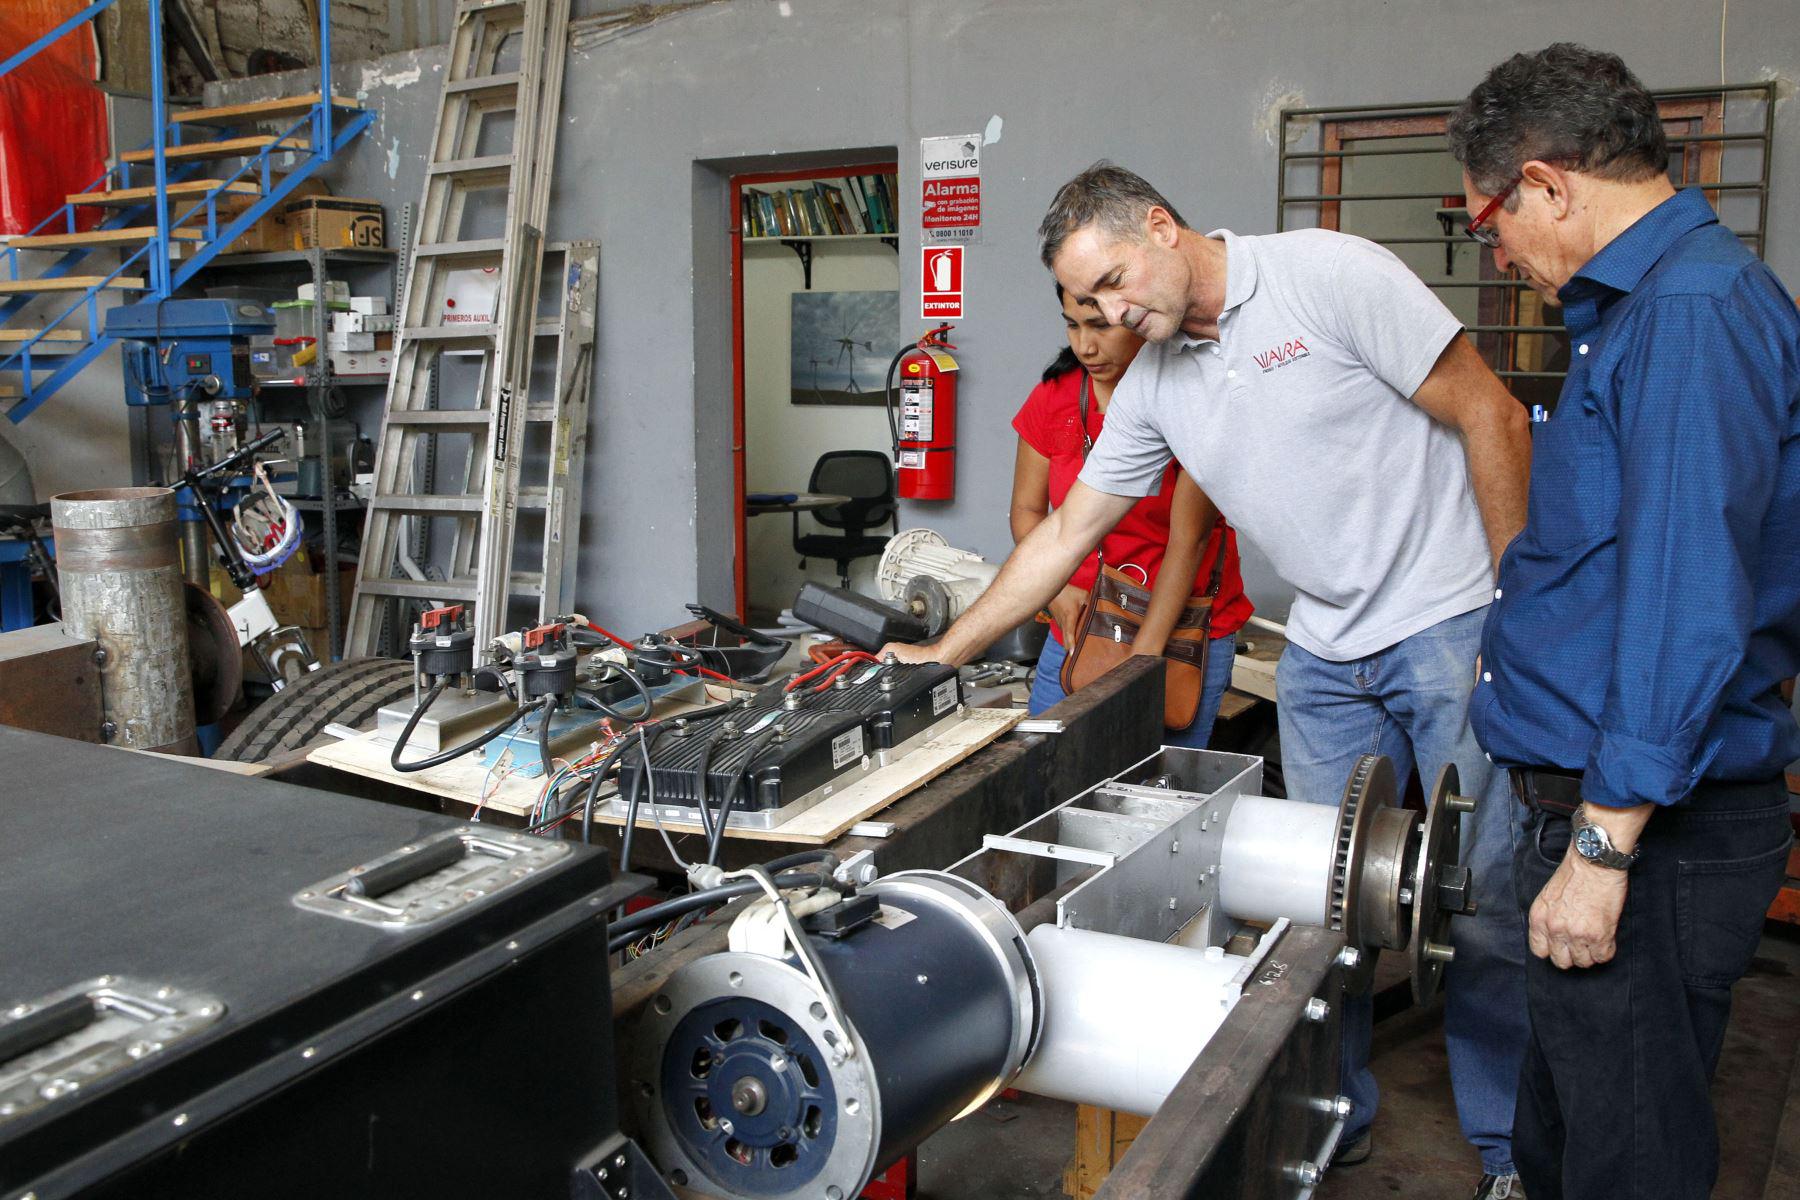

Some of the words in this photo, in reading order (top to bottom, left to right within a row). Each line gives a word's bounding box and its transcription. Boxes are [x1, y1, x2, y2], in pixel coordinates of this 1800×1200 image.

[925, 158, 978, 171] verisure
[925, 183, 978, 196] Alarma
[963, 213, 979, 221] 24H
[924, 302, 960, 310] EXTINTOR
[443, 314, 471, 322] PRIMEROS
[473, 314, 490, 322] AUXIL
